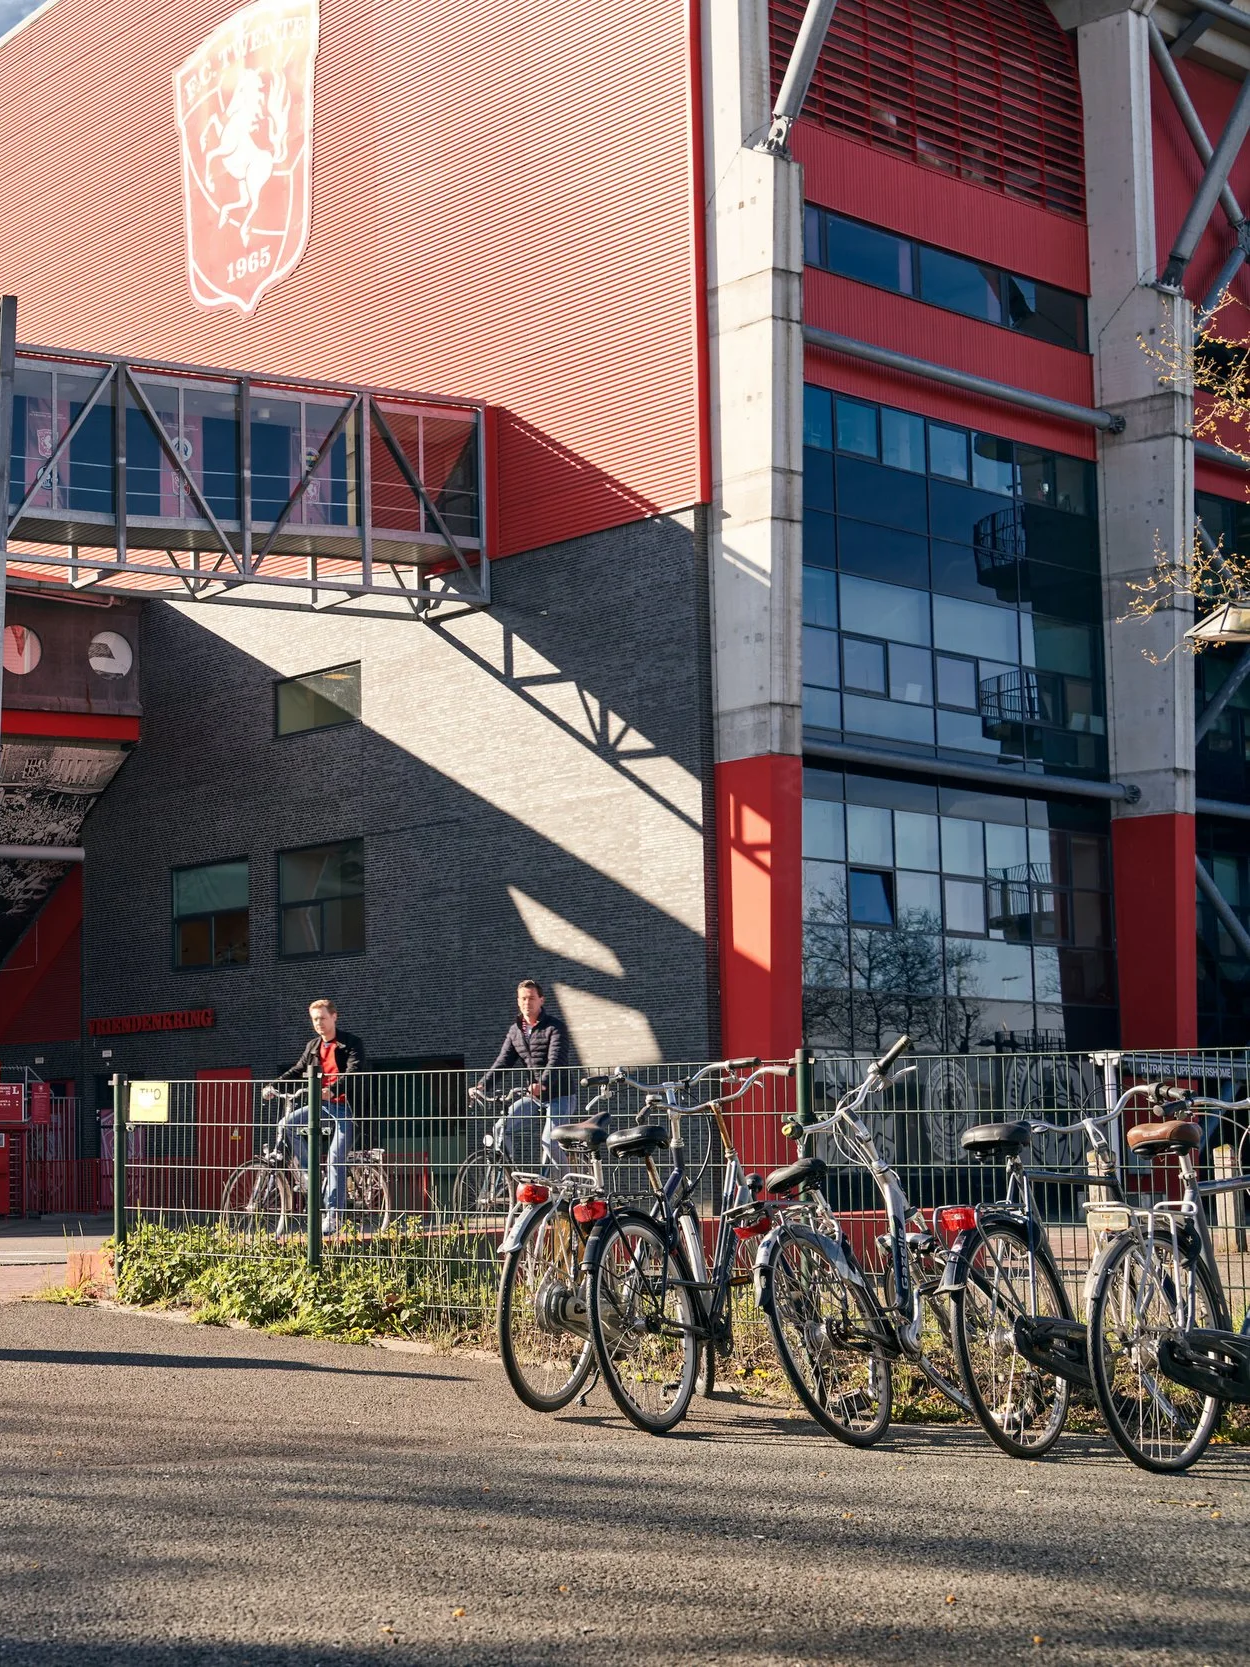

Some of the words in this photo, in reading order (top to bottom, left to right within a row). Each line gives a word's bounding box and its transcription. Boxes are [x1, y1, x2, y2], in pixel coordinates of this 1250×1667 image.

[218, 16, 306, 69] TWENTE
[226, 245, 271, 284] 1965
[88, 1008, 214, 1036] VRIENDENKRING
[12, 1086, 19, 1095] L
